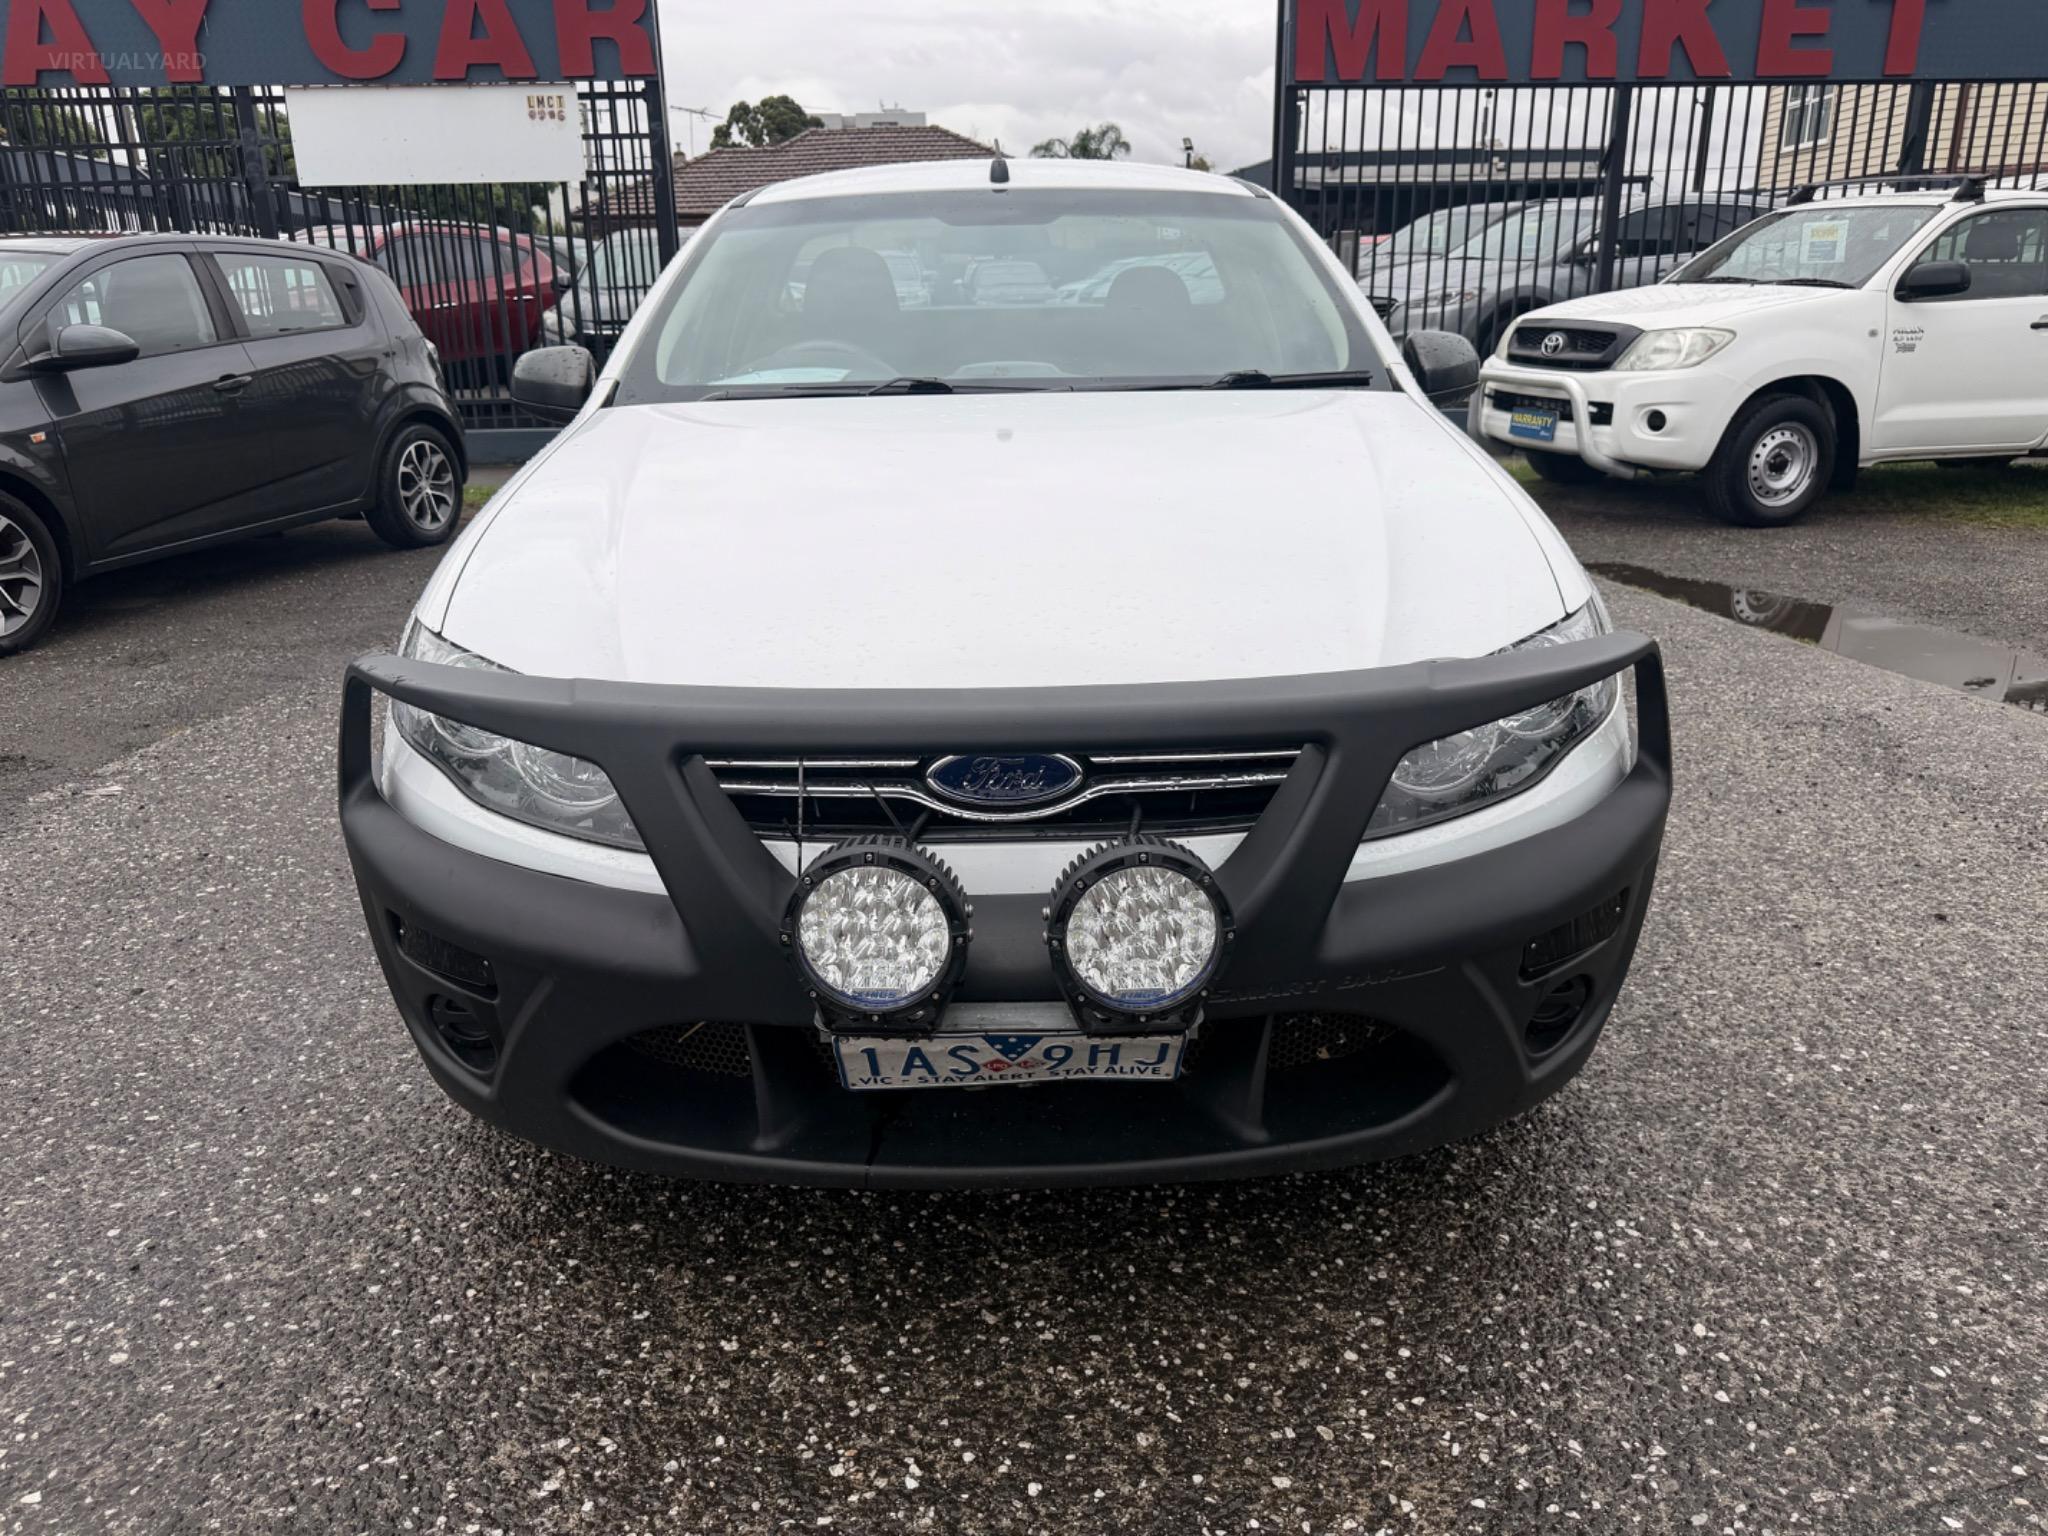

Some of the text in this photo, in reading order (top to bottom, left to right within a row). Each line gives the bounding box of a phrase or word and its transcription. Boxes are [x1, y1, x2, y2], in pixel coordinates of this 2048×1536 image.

[3, 0, 657, 86] AY CAR
[1295, 0, 1927, 81] MARKET
[526, 95, 565, 109] LMCT
[1513, 413, 1552, 427] WARRANTY
[962, 756, 1046, 791] Ford
[858, 1076, 893, 1085] VIC
[918, 1074, 965, 1084] STAY
[974, 1071, 1036, 1082] ALERT
[1050, 1066, 1097, 1077] STAY
[1104, 1065, 1161, 1075] ALIVE
[860, 1043, 1170, 1077] 1AS 9HJ
